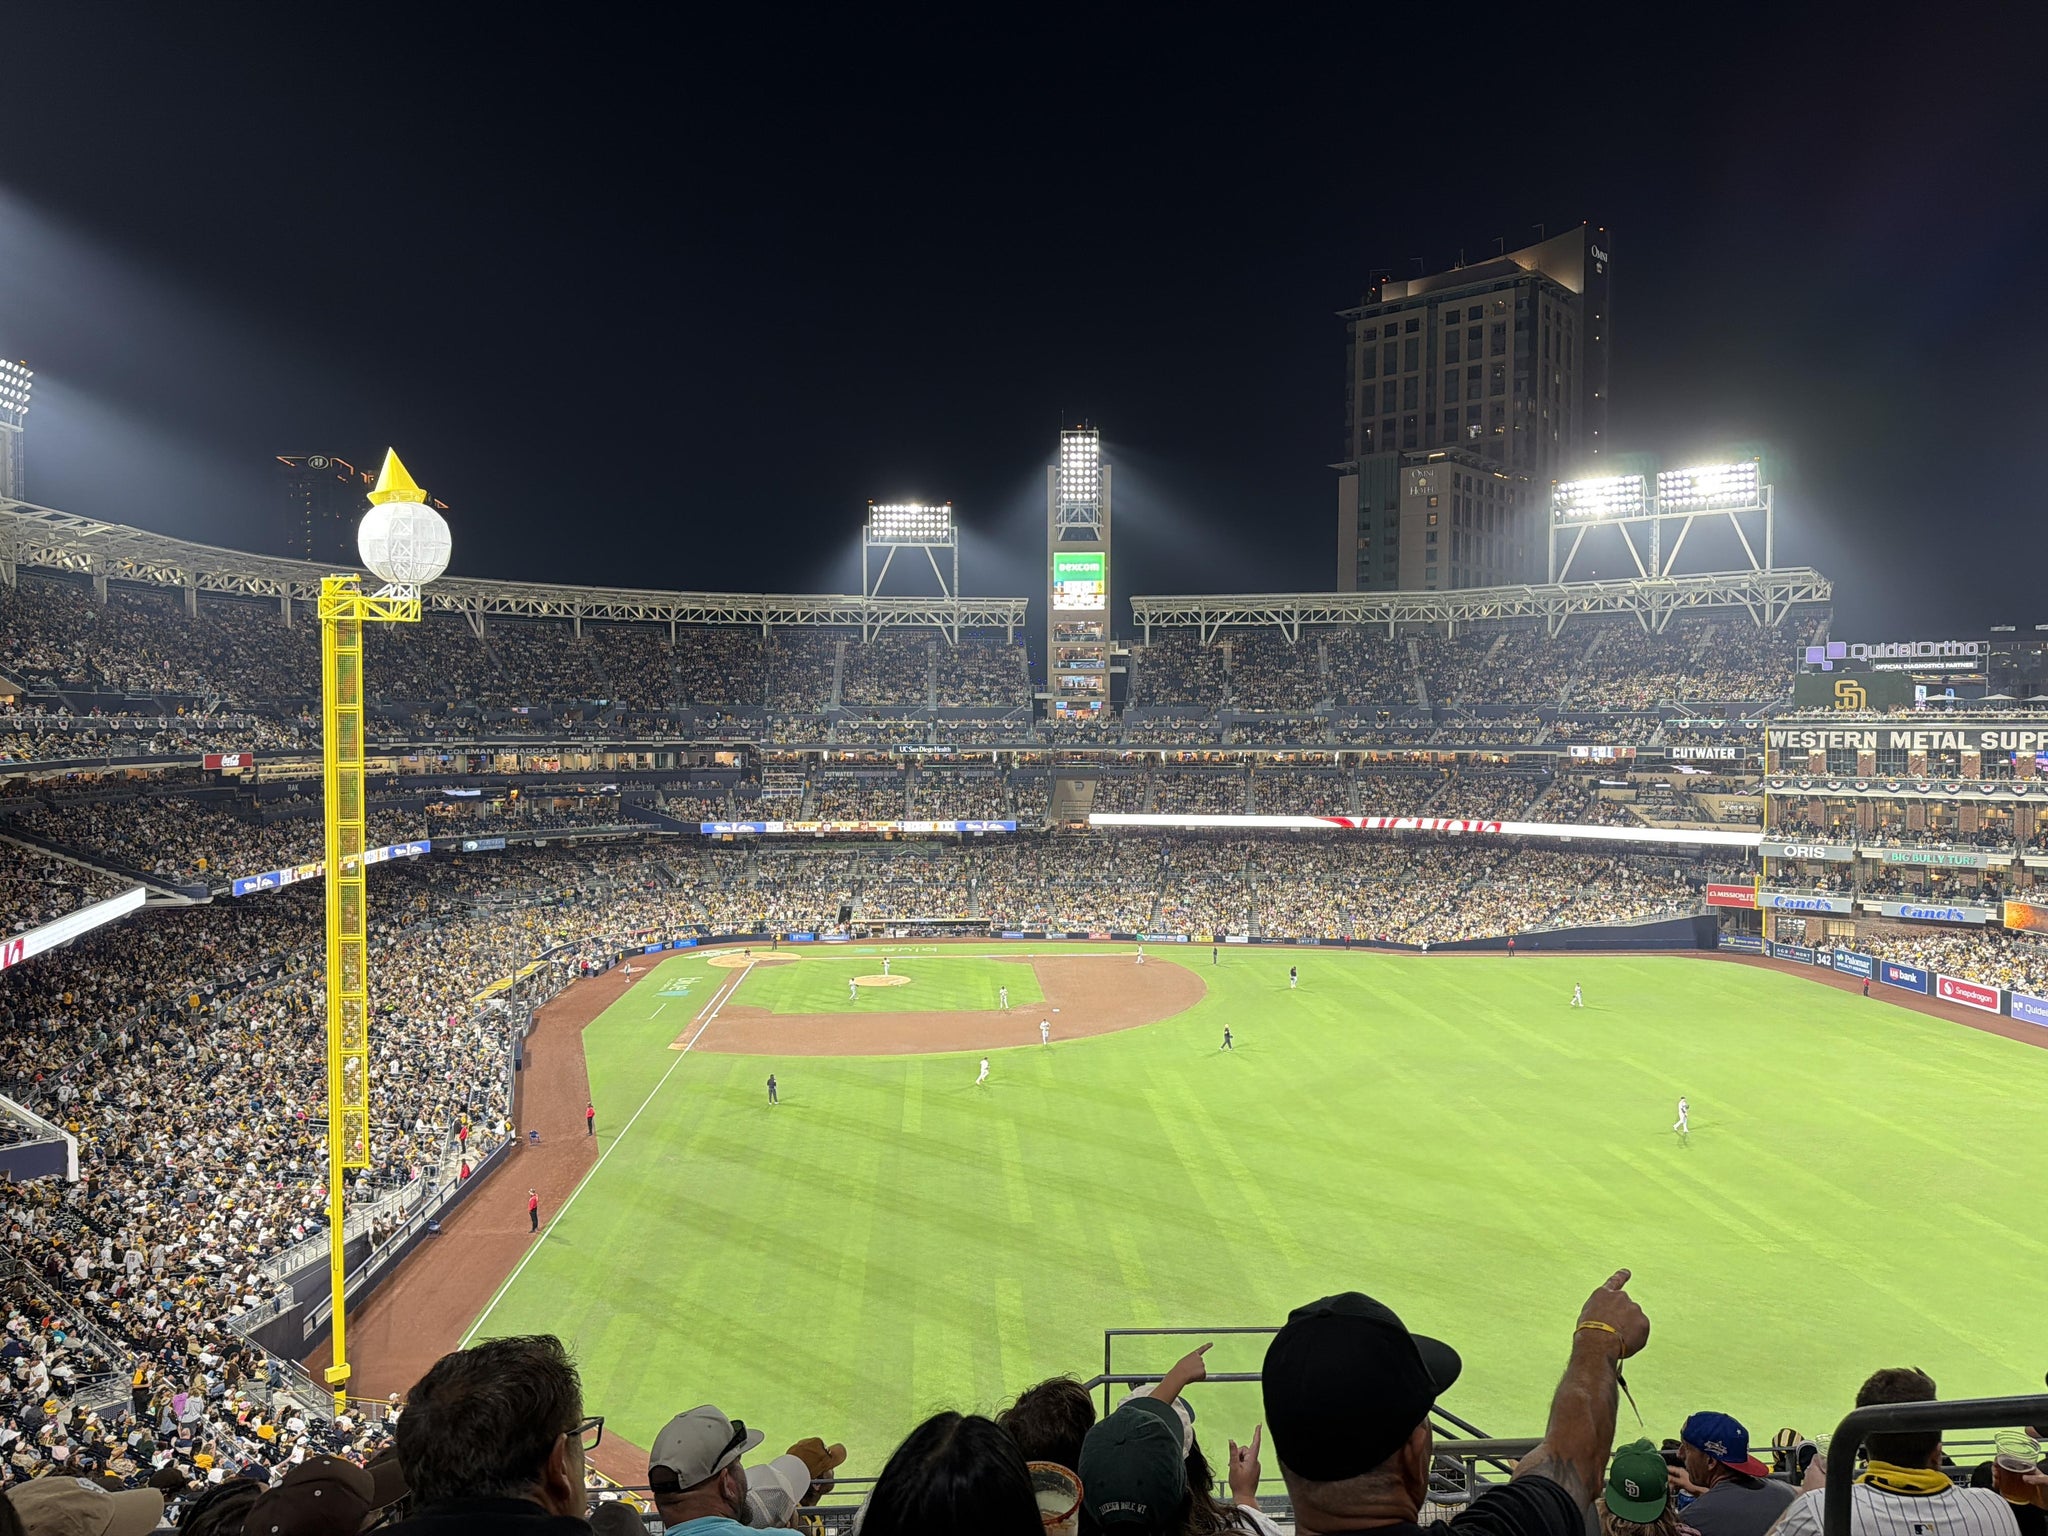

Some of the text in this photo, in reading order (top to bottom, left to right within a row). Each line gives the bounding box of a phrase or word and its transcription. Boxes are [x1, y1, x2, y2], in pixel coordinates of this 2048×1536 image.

[1851, 640, 1979, 662] QuidelOrtho
[1903, 662, 1944, 670] DIAGNOSTICS
[1768, 731, 1877, 749] WESTERN
[1889, 731, 1973, 750] METAL
[1672, 747, 1736, 759] CUTWATER
[1783, 845, 1826, 858] ORIS
[1891, 852, 1977, 865] BIG BULLY TURF
[1716, 891, 1746, 899] MISSION
[1816, 953, 1832, 966] 342
[1899, 970, 1918, 984] bank
[1954, 984, 1993, 1003] Snapdragon
